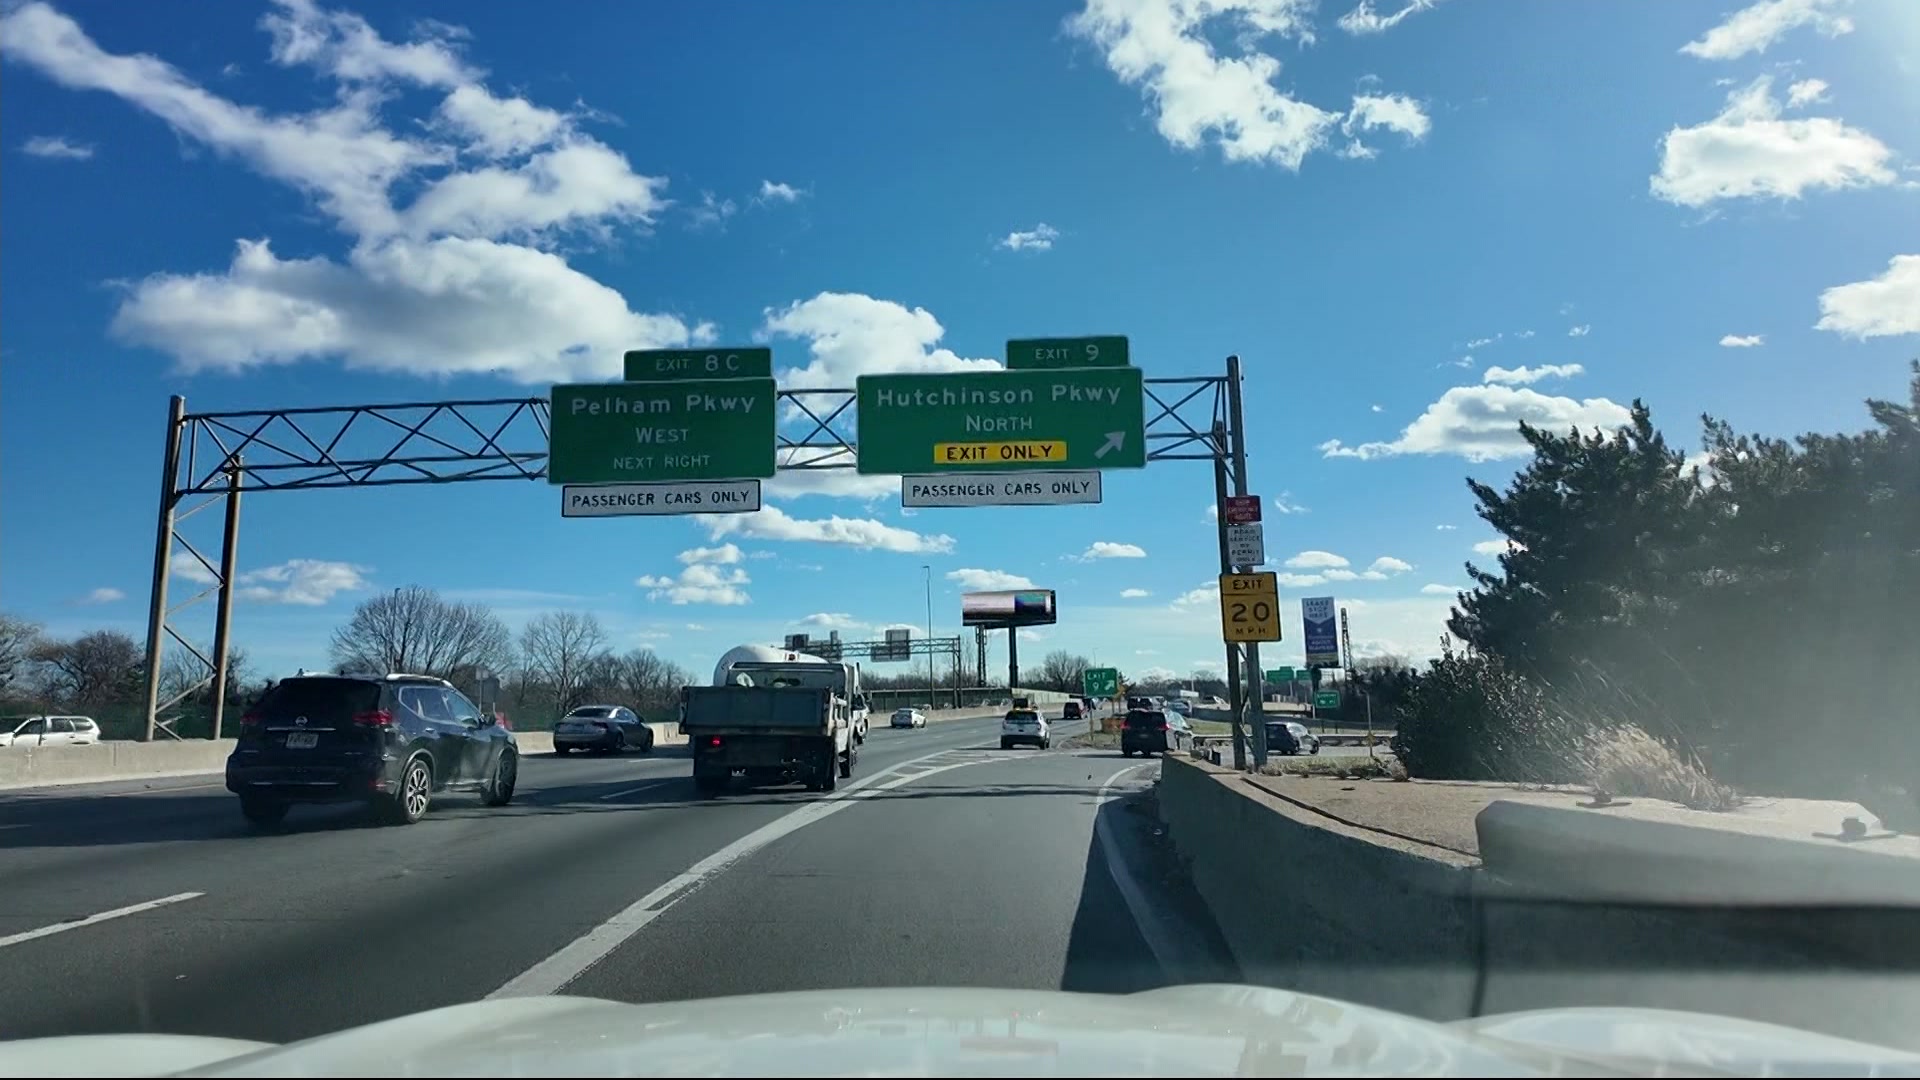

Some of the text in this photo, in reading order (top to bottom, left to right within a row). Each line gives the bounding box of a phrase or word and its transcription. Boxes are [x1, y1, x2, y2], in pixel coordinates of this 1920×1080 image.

[1034, 345, 1099, 361] EXIT 9
[655, 358, 691, 371] EXIT
[877, 384, 1121, 407] Hutchinson Pkwy
[571, 394, 756, 416] Pelham Pkwy
[966, 415, 1033, 432] NORTH
[635, 427, 689, 444] WEST
[946, 445, 1053, 460] EXIT ONLY
[613, 455, 711, 470] NEXT RIGHT
[911, 480, 1090, 498] PASSENGER CARS ONLY
[571, 489, 750, 507] PASSENGER CARS ONLY
[1233, 578, 1263, 591] EXIT
[1231, 602, 1270, 622] 20
[1092, 682, 1099, 692] 9
